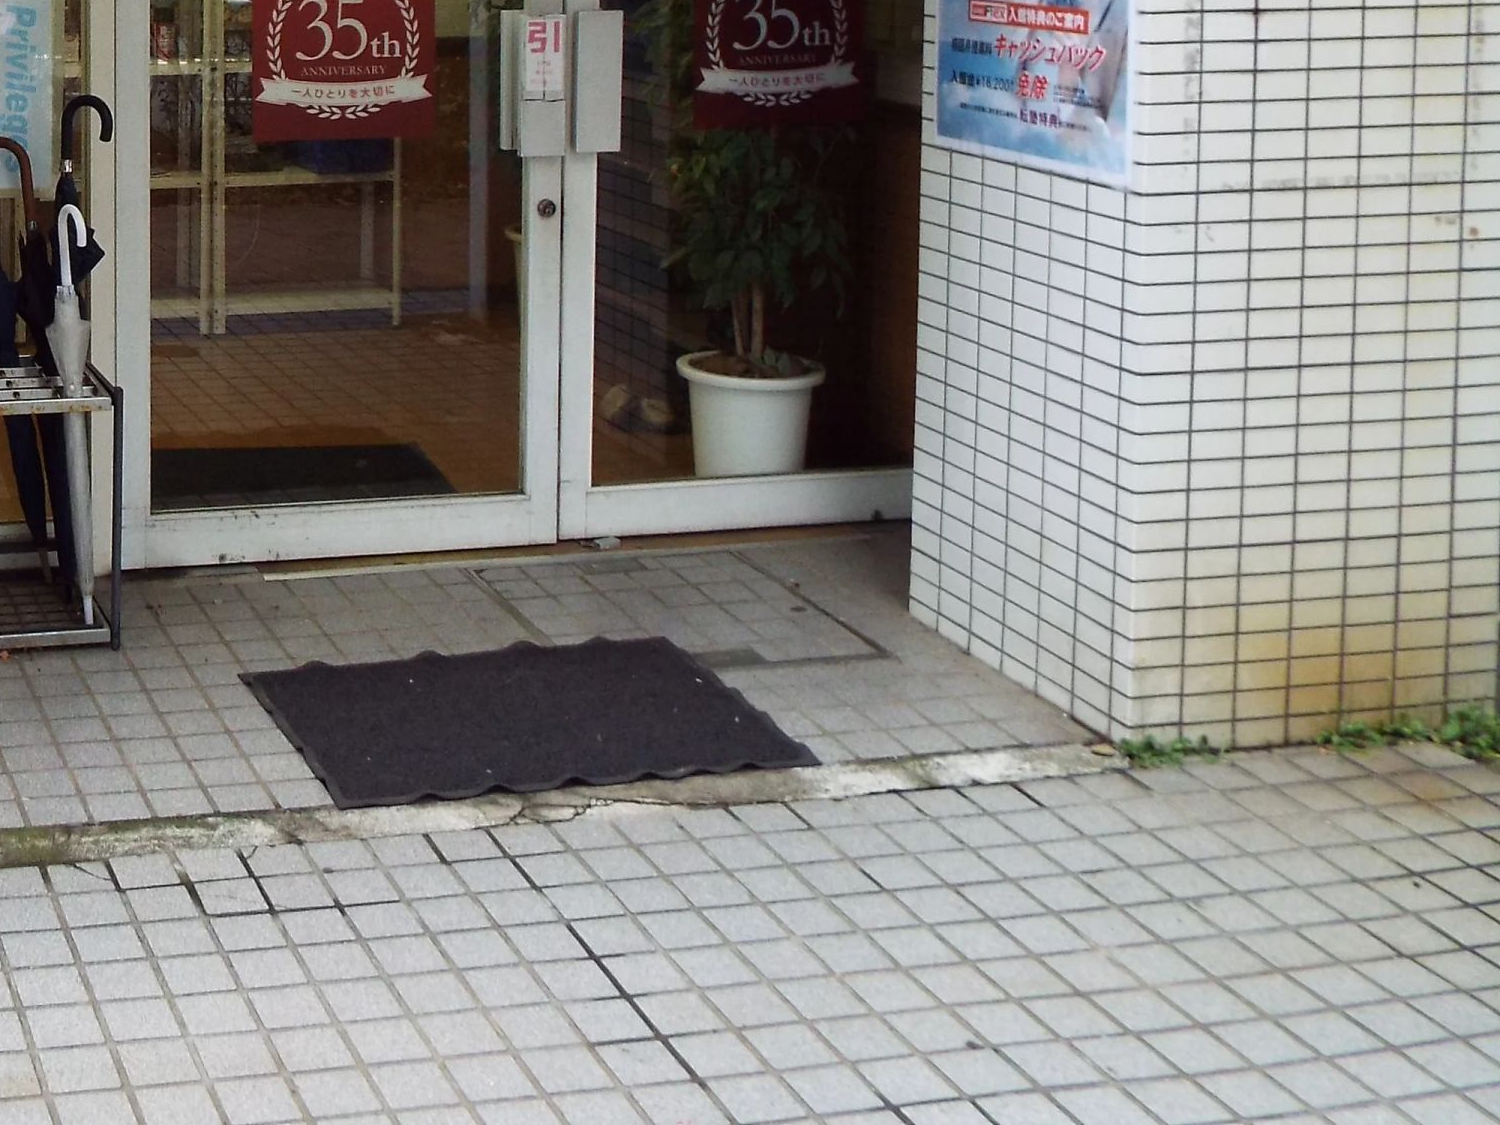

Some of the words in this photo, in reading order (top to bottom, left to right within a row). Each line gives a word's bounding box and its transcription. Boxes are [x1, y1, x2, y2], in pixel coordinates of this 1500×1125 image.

[528, 20, 560, 53] 引
[995, 34, 1106, 72] キャッシュバック
[302, 65, 387, 76] ANNIVERSARY
[291, 85, 396, 100] 一人ひとりを大切に
